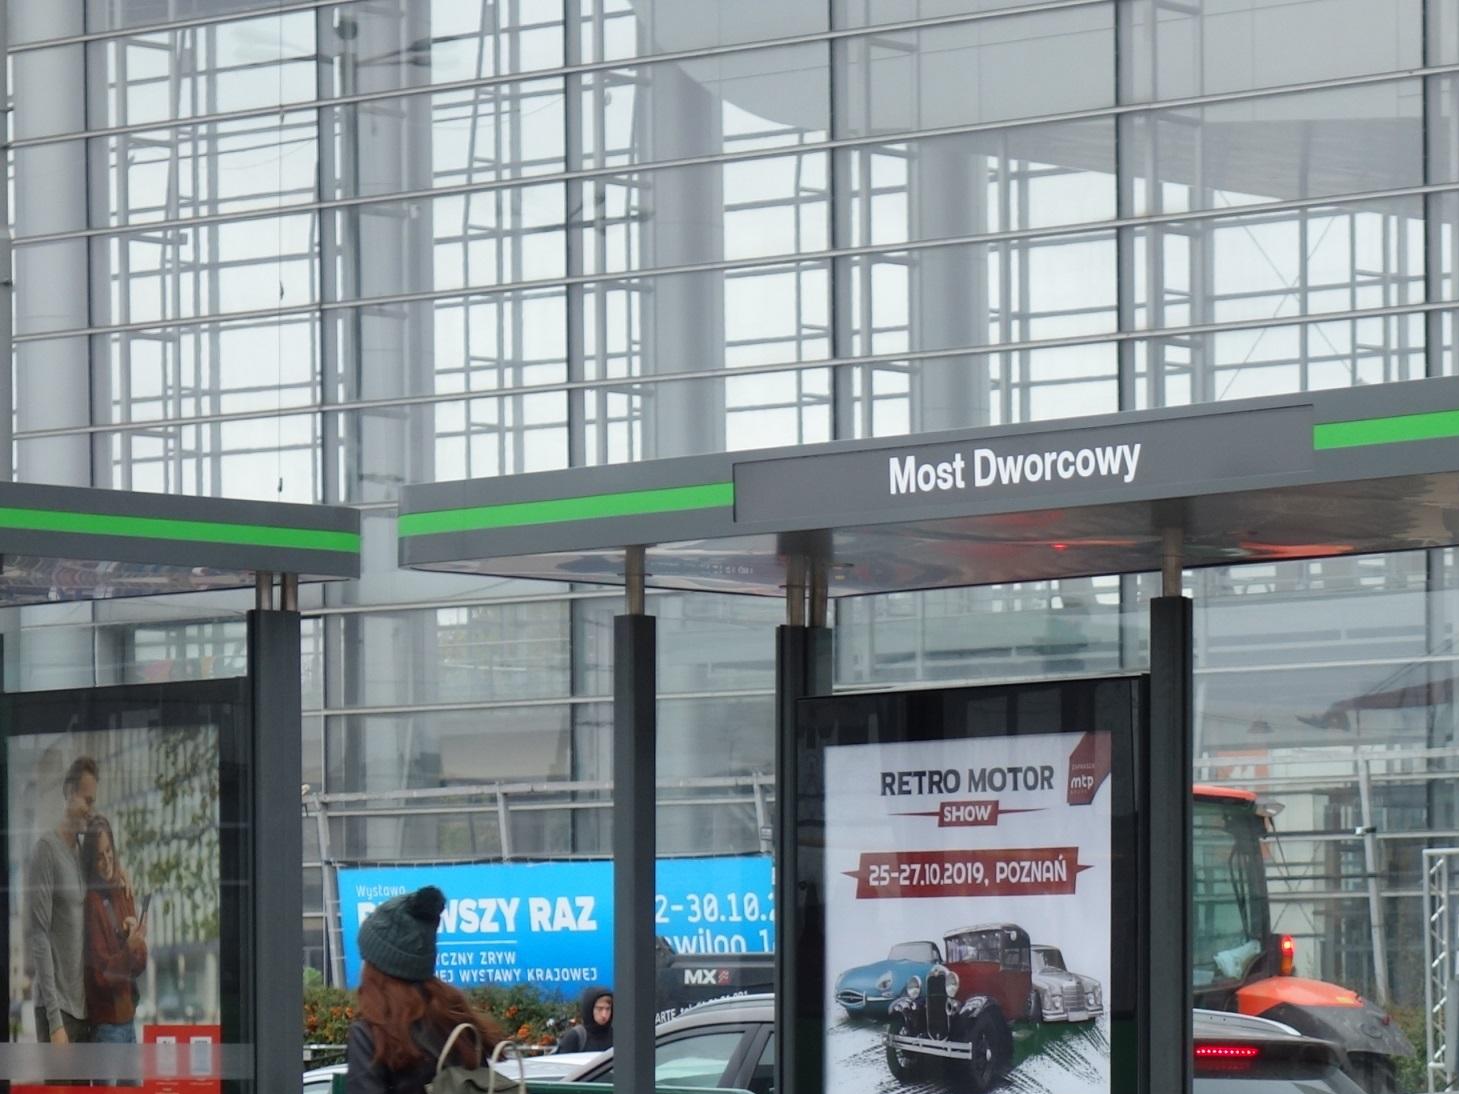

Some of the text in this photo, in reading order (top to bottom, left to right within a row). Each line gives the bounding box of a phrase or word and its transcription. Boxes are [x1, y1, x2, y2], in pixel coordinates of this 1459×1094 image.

[889, 443, 1141, 495] Most Dworcowy
[880, 765, 1054, 796] RETRO MOTOR
[1071, 775, 1094, 790] mtp
[943, 805, 992, 822] SHOW
[869, 854, 1067, 886] 25-27.10.2019, POZNAŃ
[356, 884, 406, 900] Wystawa
[528, 895, 598, 932] RAZ
[480, 951, 516, 965] ZRYW
[460, 968, 521, 981] WYSTAWY
[527, 968, 597, 981] KRAJOWEJ
[684, 968, 717, 985] MX
